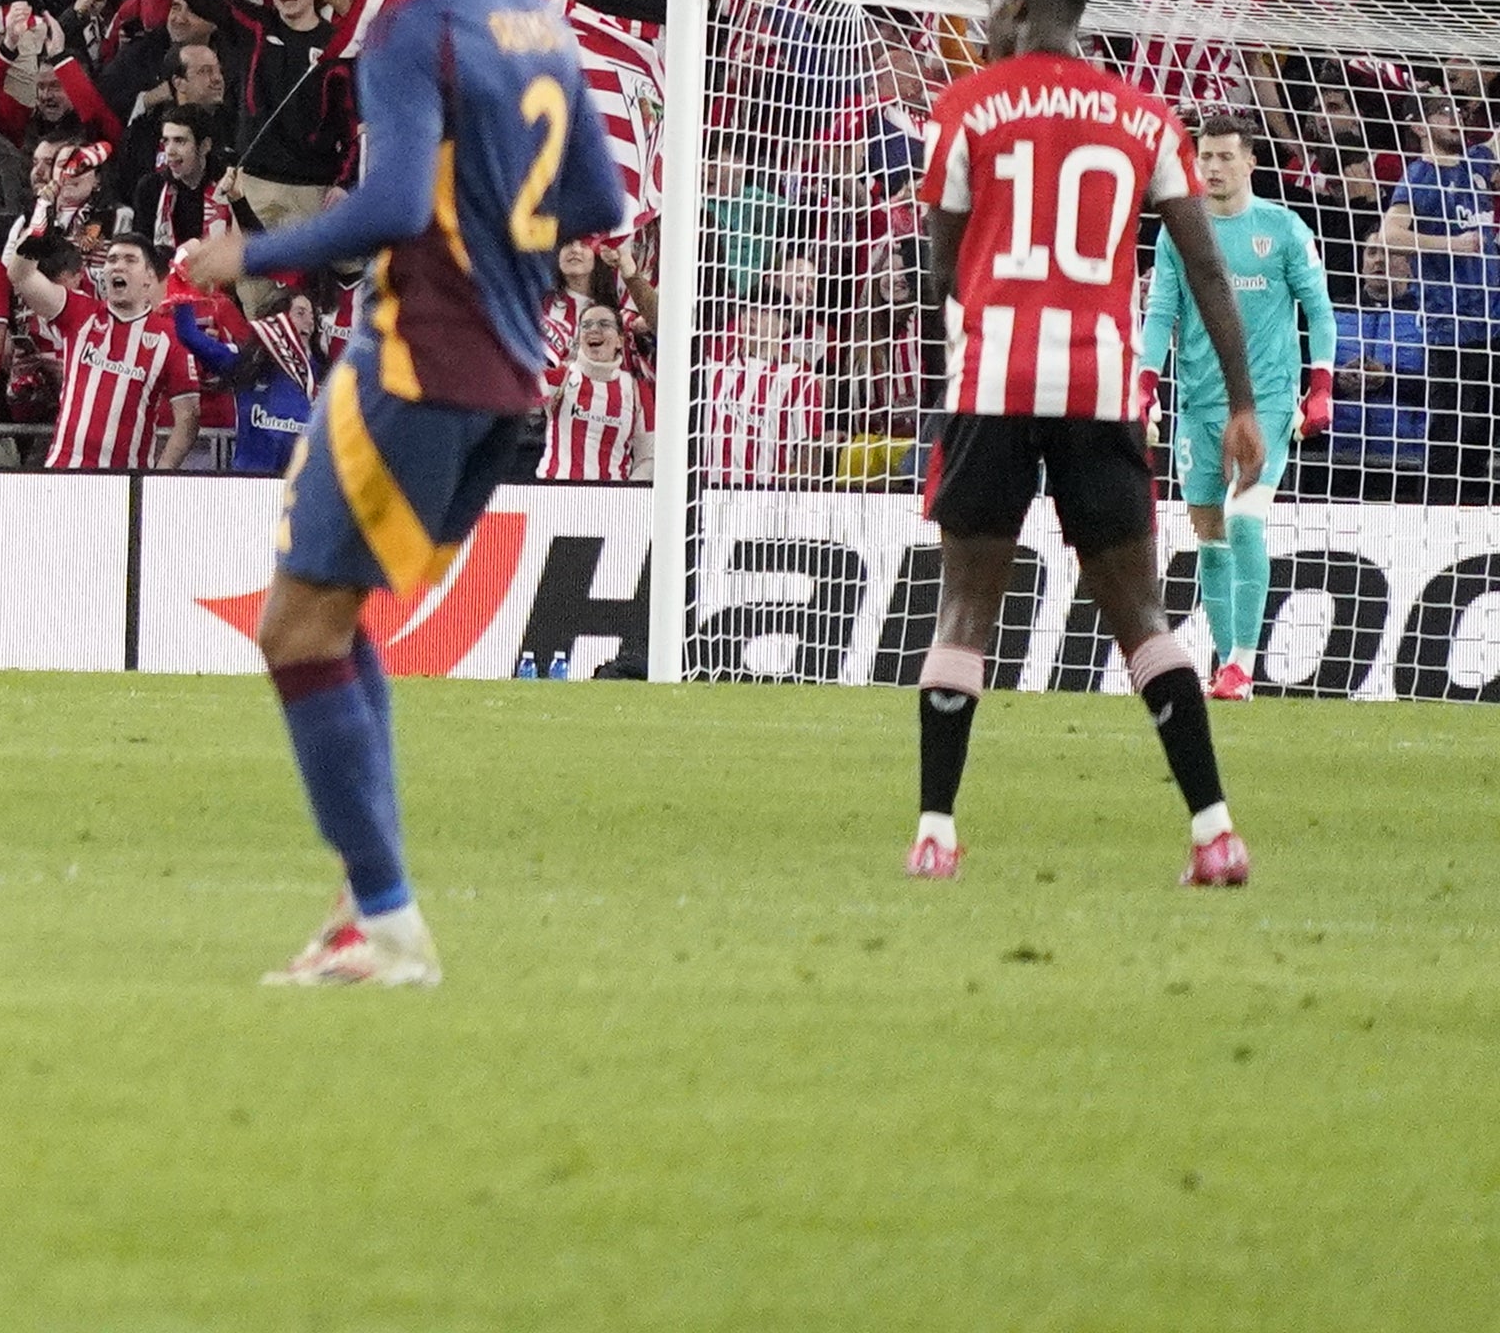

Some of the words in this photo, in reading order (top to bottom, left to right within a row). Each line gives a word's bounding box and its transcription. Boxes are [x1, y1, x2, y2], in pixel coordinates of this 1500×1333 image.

[963, 85, 1117, 136] WILLIAMS
[512, 76, 566, 255] 2
[993, 139, 1135, 285] 10
[82, 345, 146, 379] Kutxabank
[570, 404, 624, 430] Kutxabank
